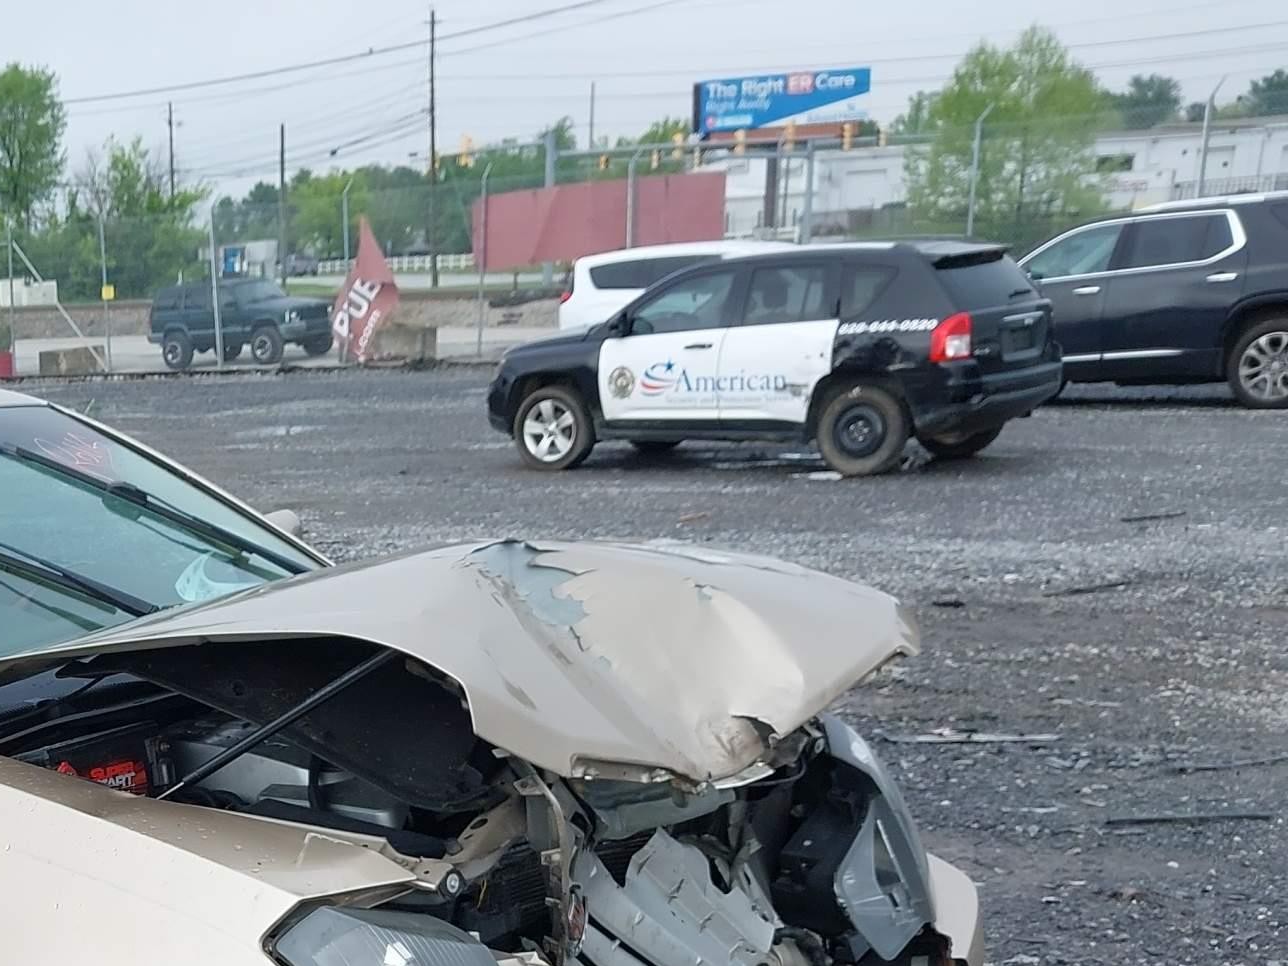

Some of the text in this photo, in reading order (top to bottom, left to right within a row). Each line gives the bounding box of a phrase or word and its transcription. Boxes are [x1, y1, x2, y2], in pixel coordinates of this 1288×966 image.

[707, 73, 856, 99] The Right ER Care
[674, 368, 787, 393] American
